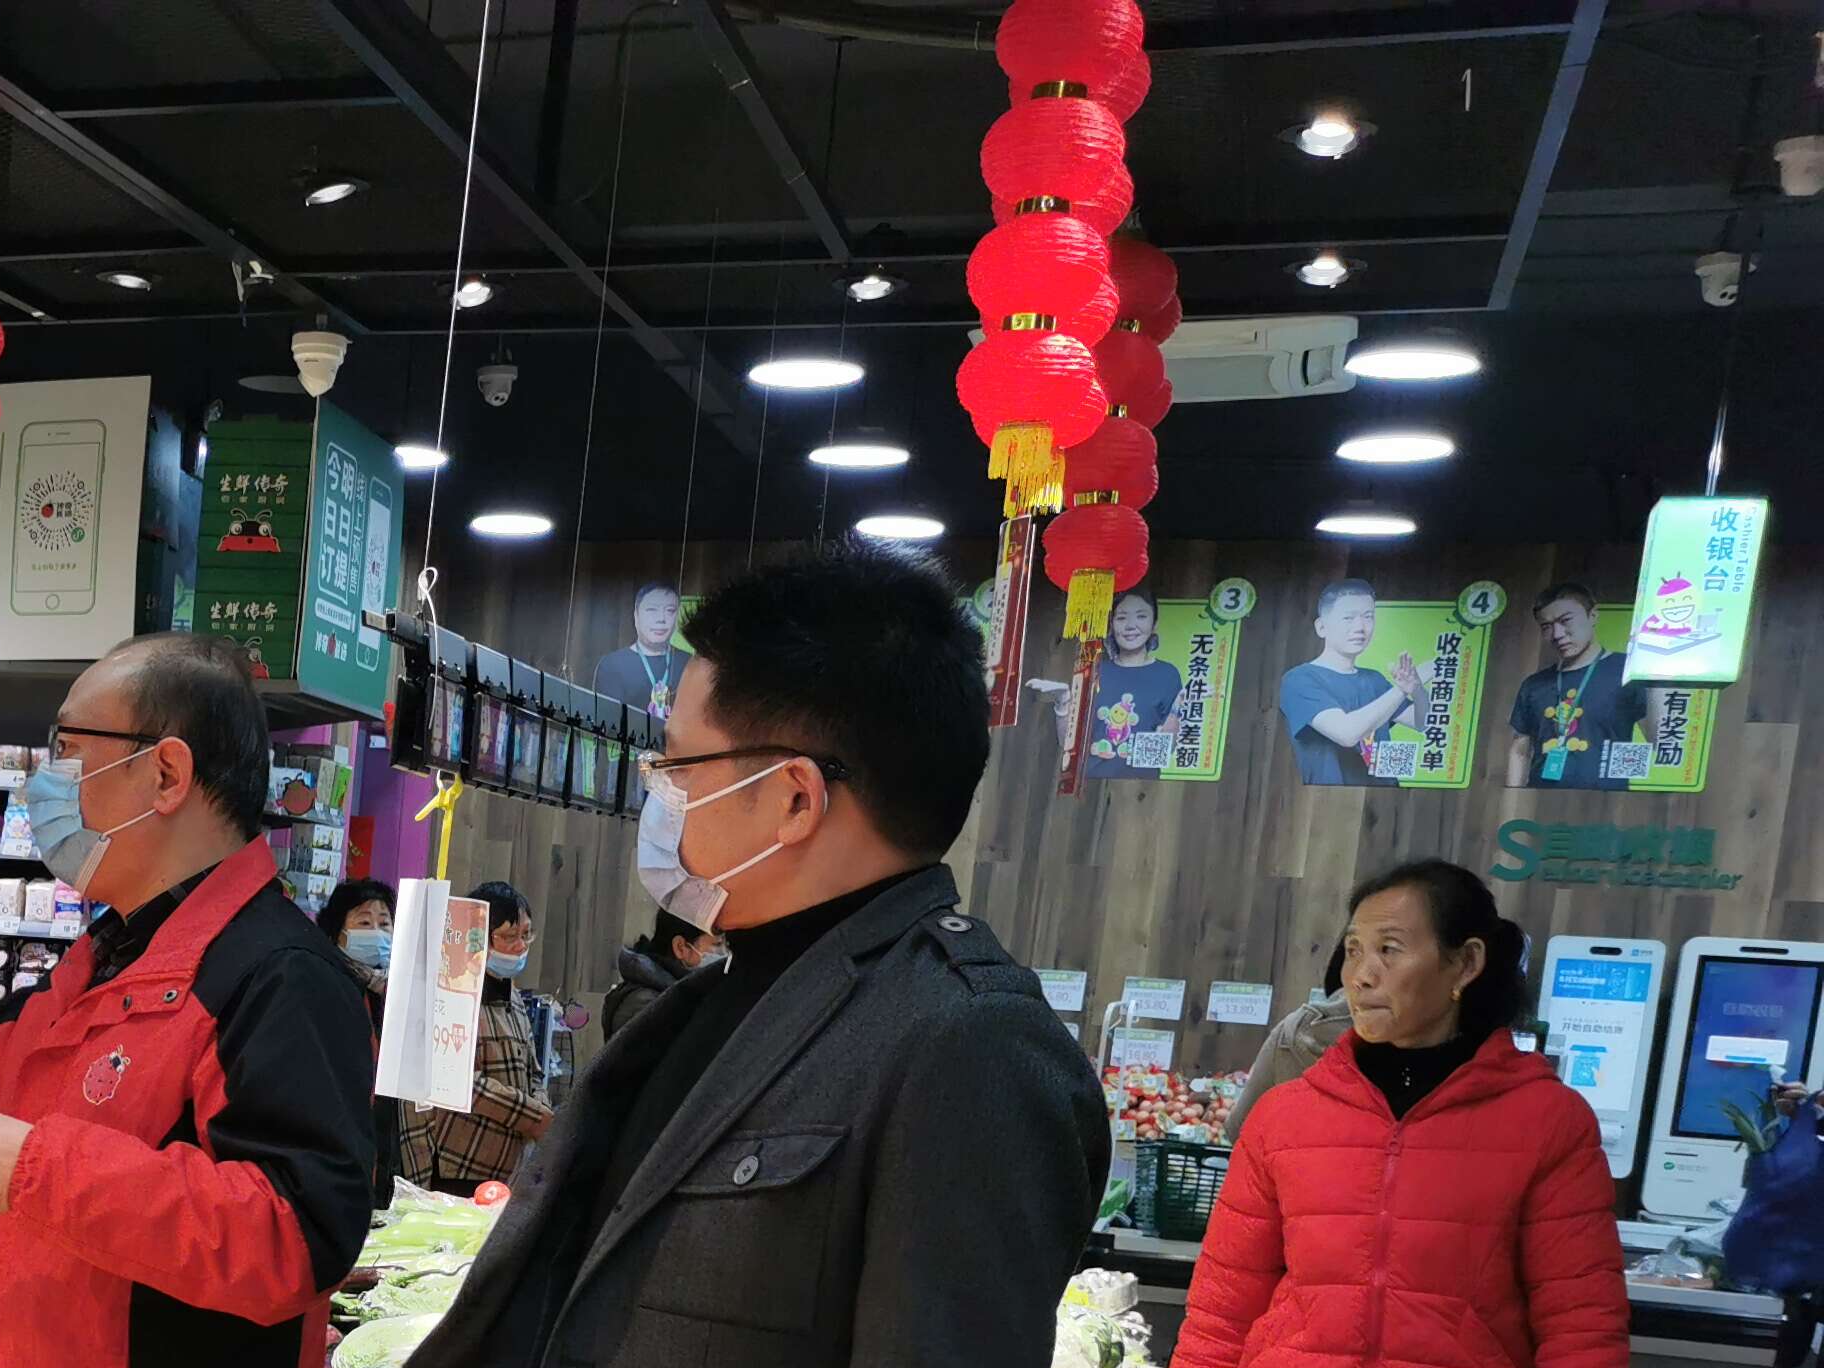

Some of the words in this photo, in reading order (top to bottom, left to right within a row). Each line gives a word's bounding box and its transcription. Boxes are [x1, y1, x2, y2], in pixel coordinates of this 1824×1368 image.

[219, 474, 288, 498] 生鲜传奇
[1704, 506, 1739, 592] 收银台
[210, 601, 278, 624] 生鲜传奇
[1225, 587, 1242, 610] 3
[1472, 591, 1490, 614] 4
[1175, 634, 1214, 769] 无条件退差额
[1420, 632, 1463, 772] 收错商品免单
[1655, 690, 1691, 767] 有奖励
